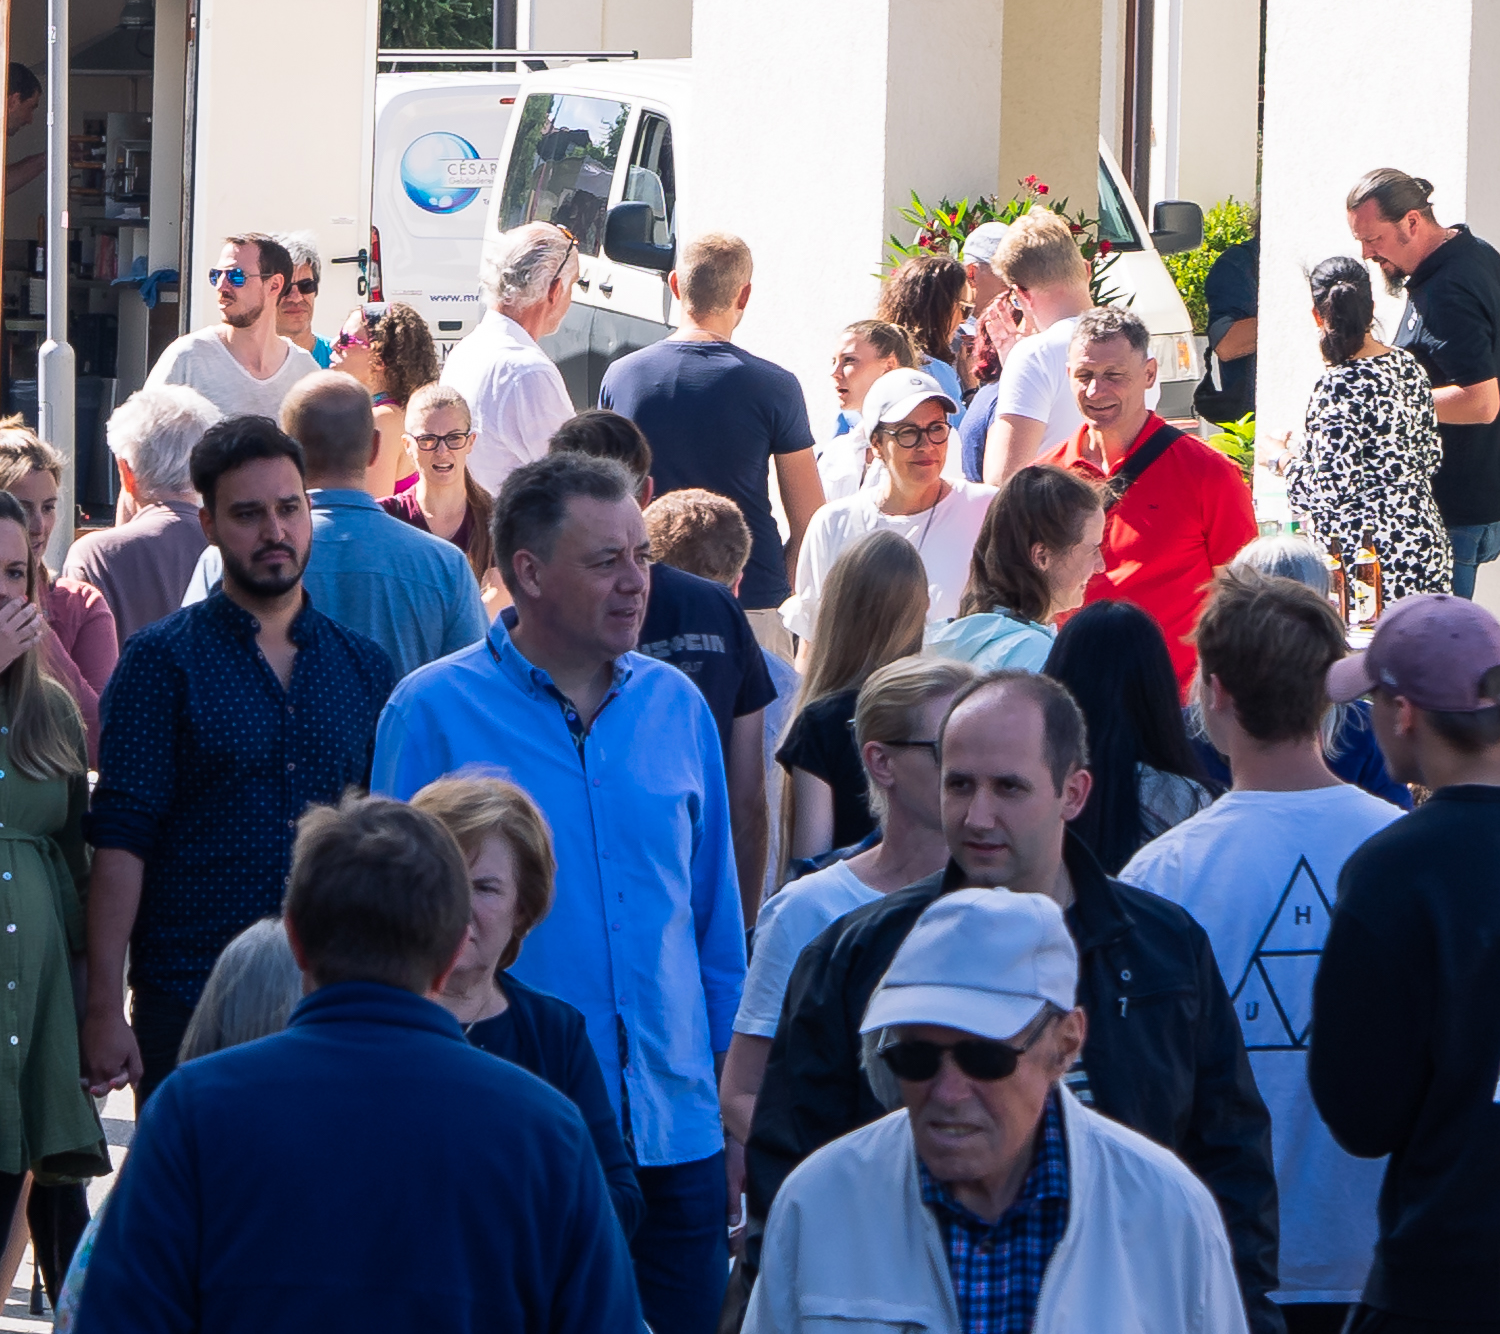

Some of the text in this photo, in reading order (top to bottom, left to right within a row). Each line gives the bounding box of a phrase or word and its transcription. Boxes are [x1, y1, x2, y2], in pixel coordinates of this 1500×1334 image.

[447, 160, 497, 176] CÉSAR
[1294, 905, 1312, 926] H
[1245, 1001, 1260, 1021] U
